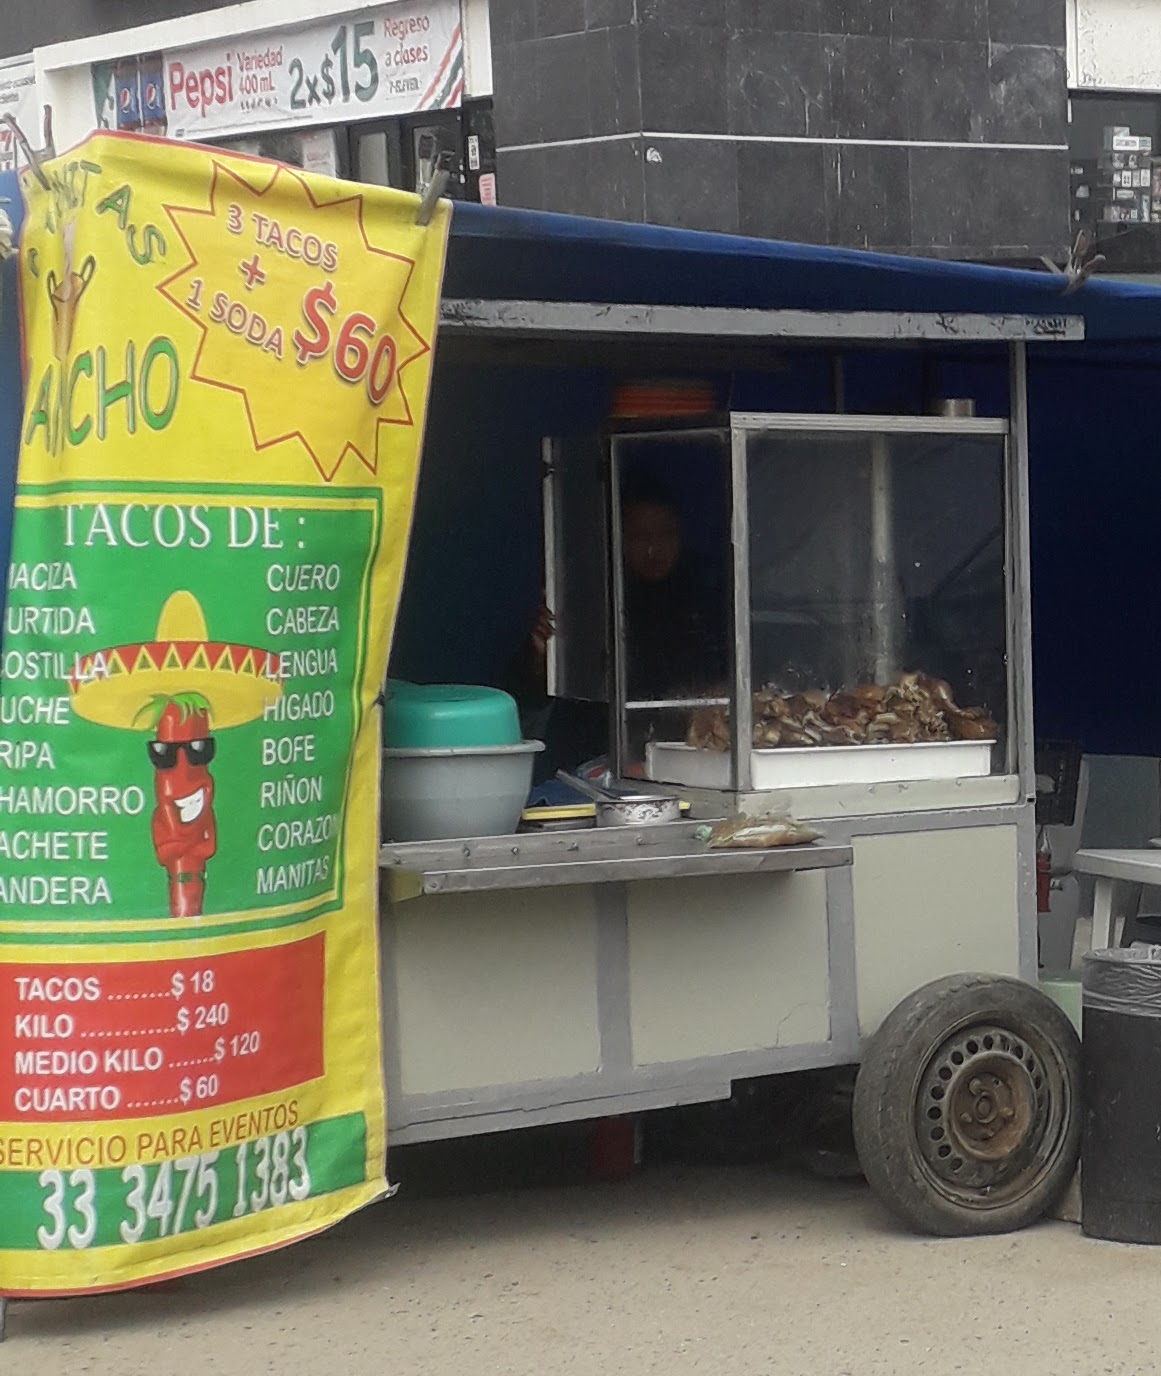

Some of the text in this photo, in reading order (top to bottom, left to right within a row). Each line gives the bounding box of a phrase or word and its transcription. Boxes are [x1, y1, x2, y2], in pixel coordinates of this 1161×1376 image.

[383, 14, 430, 41] Regreso
[237, 44, 284, 72] Variedad
[384, 42, 429, 67] a clases
[168, 51, 235, 119] Pepsi
[239, 74, 259, 96] 400
[227, 203, 339, 273] 3 TACOS
[186, 278, 284, 360] 1 SODA
[293, 279, 398, 405] $60
[60, 504, 210, 549] TACOS
[228, 504, 284, 549] DE
[267, 564, 341, 592] CUERO
[266, 606, 340, 635] CABEZA
[2, 651, 111, 681] OSTILLA
[266, 647, 339, 679] LENGUA
[264, 689, 334, 722] HIGADO
[262, 734, 316, 766] BOFE
[260, 774, 323, 809] RIÑON
[256, 855, 330, 895] MANITAS
[14, 977, 101, 1002] TACOS
[190, 969, 215, 994] 18
[14, 1013, 75, 1039] KILO
[194, 1002, 230, 1030] 240
[14, 1050, 98, 1076] MEDIO
[104, 1047, 163, 1073] KILO
[229, 1030, 261, 1057] 120
[14, 1084, 121, 1112] CUARTO
[195, 1073, 219, 1099] 60
[136, 1124, 202, 1161] PARA
[209, 1098, 300, 1149] EVENTOS
[37, 1124, 312, 1251] 33 3475 1383
